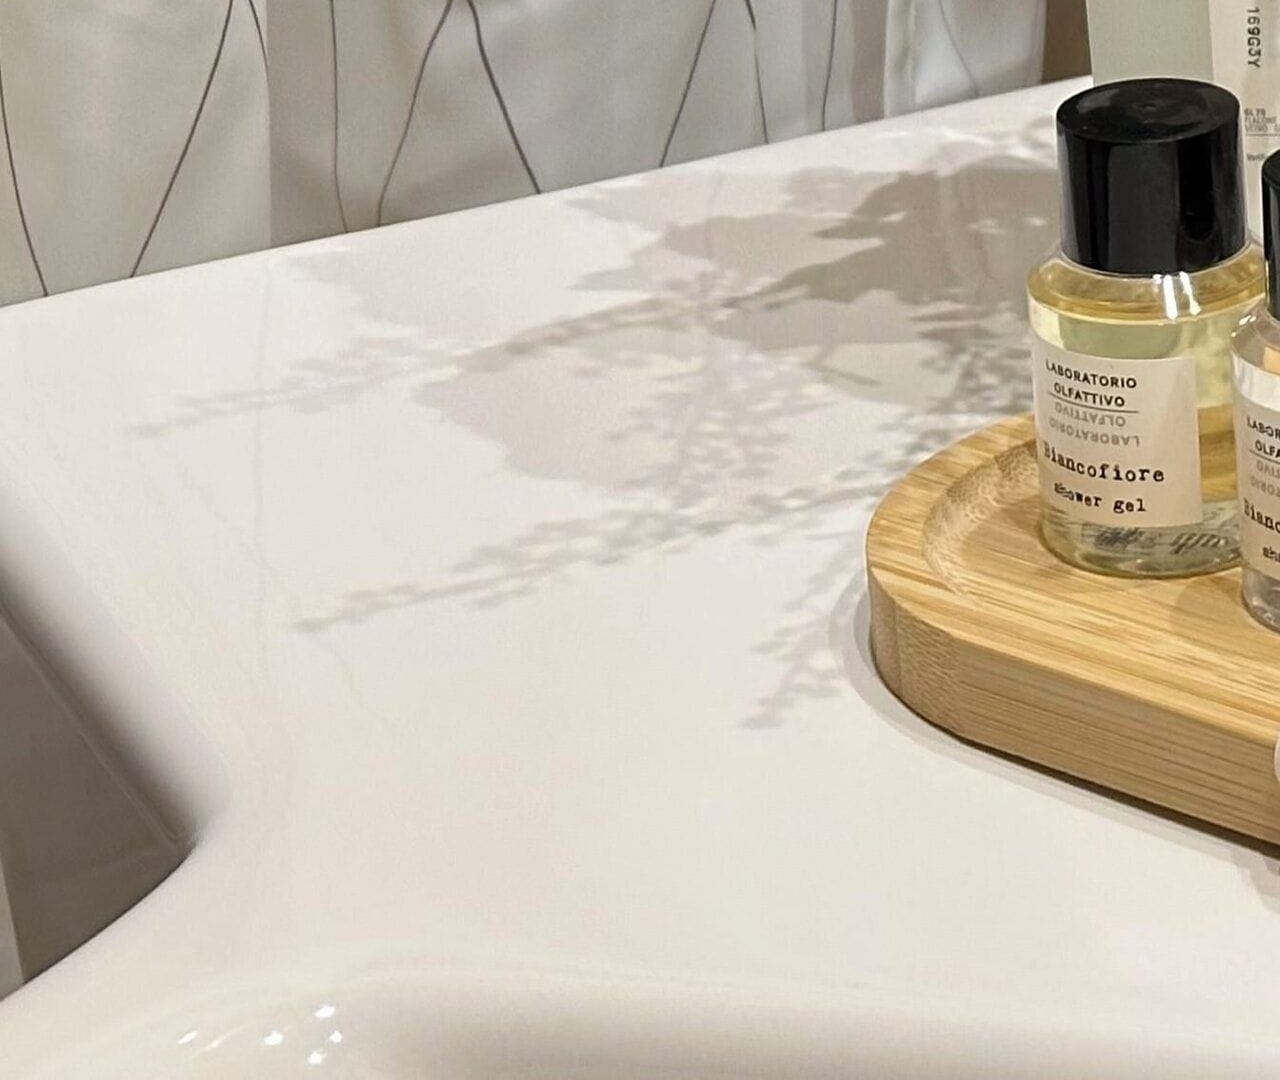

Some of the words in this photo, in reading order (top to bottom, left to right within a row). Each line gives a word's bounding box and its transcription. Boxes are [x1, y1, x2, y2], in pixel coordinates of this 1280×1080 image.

[1247, 6, 1262, 68] 169G3Y
[1046, 359, 1138, 389] LABORATORIO
[1054, 382, 1125, 407] OLFATTIVO
[1043, 440, 1165, 483] Biancofiore
[1054, 482, 1102, 507] shower
[1113, 498, 1146, 514] gel
